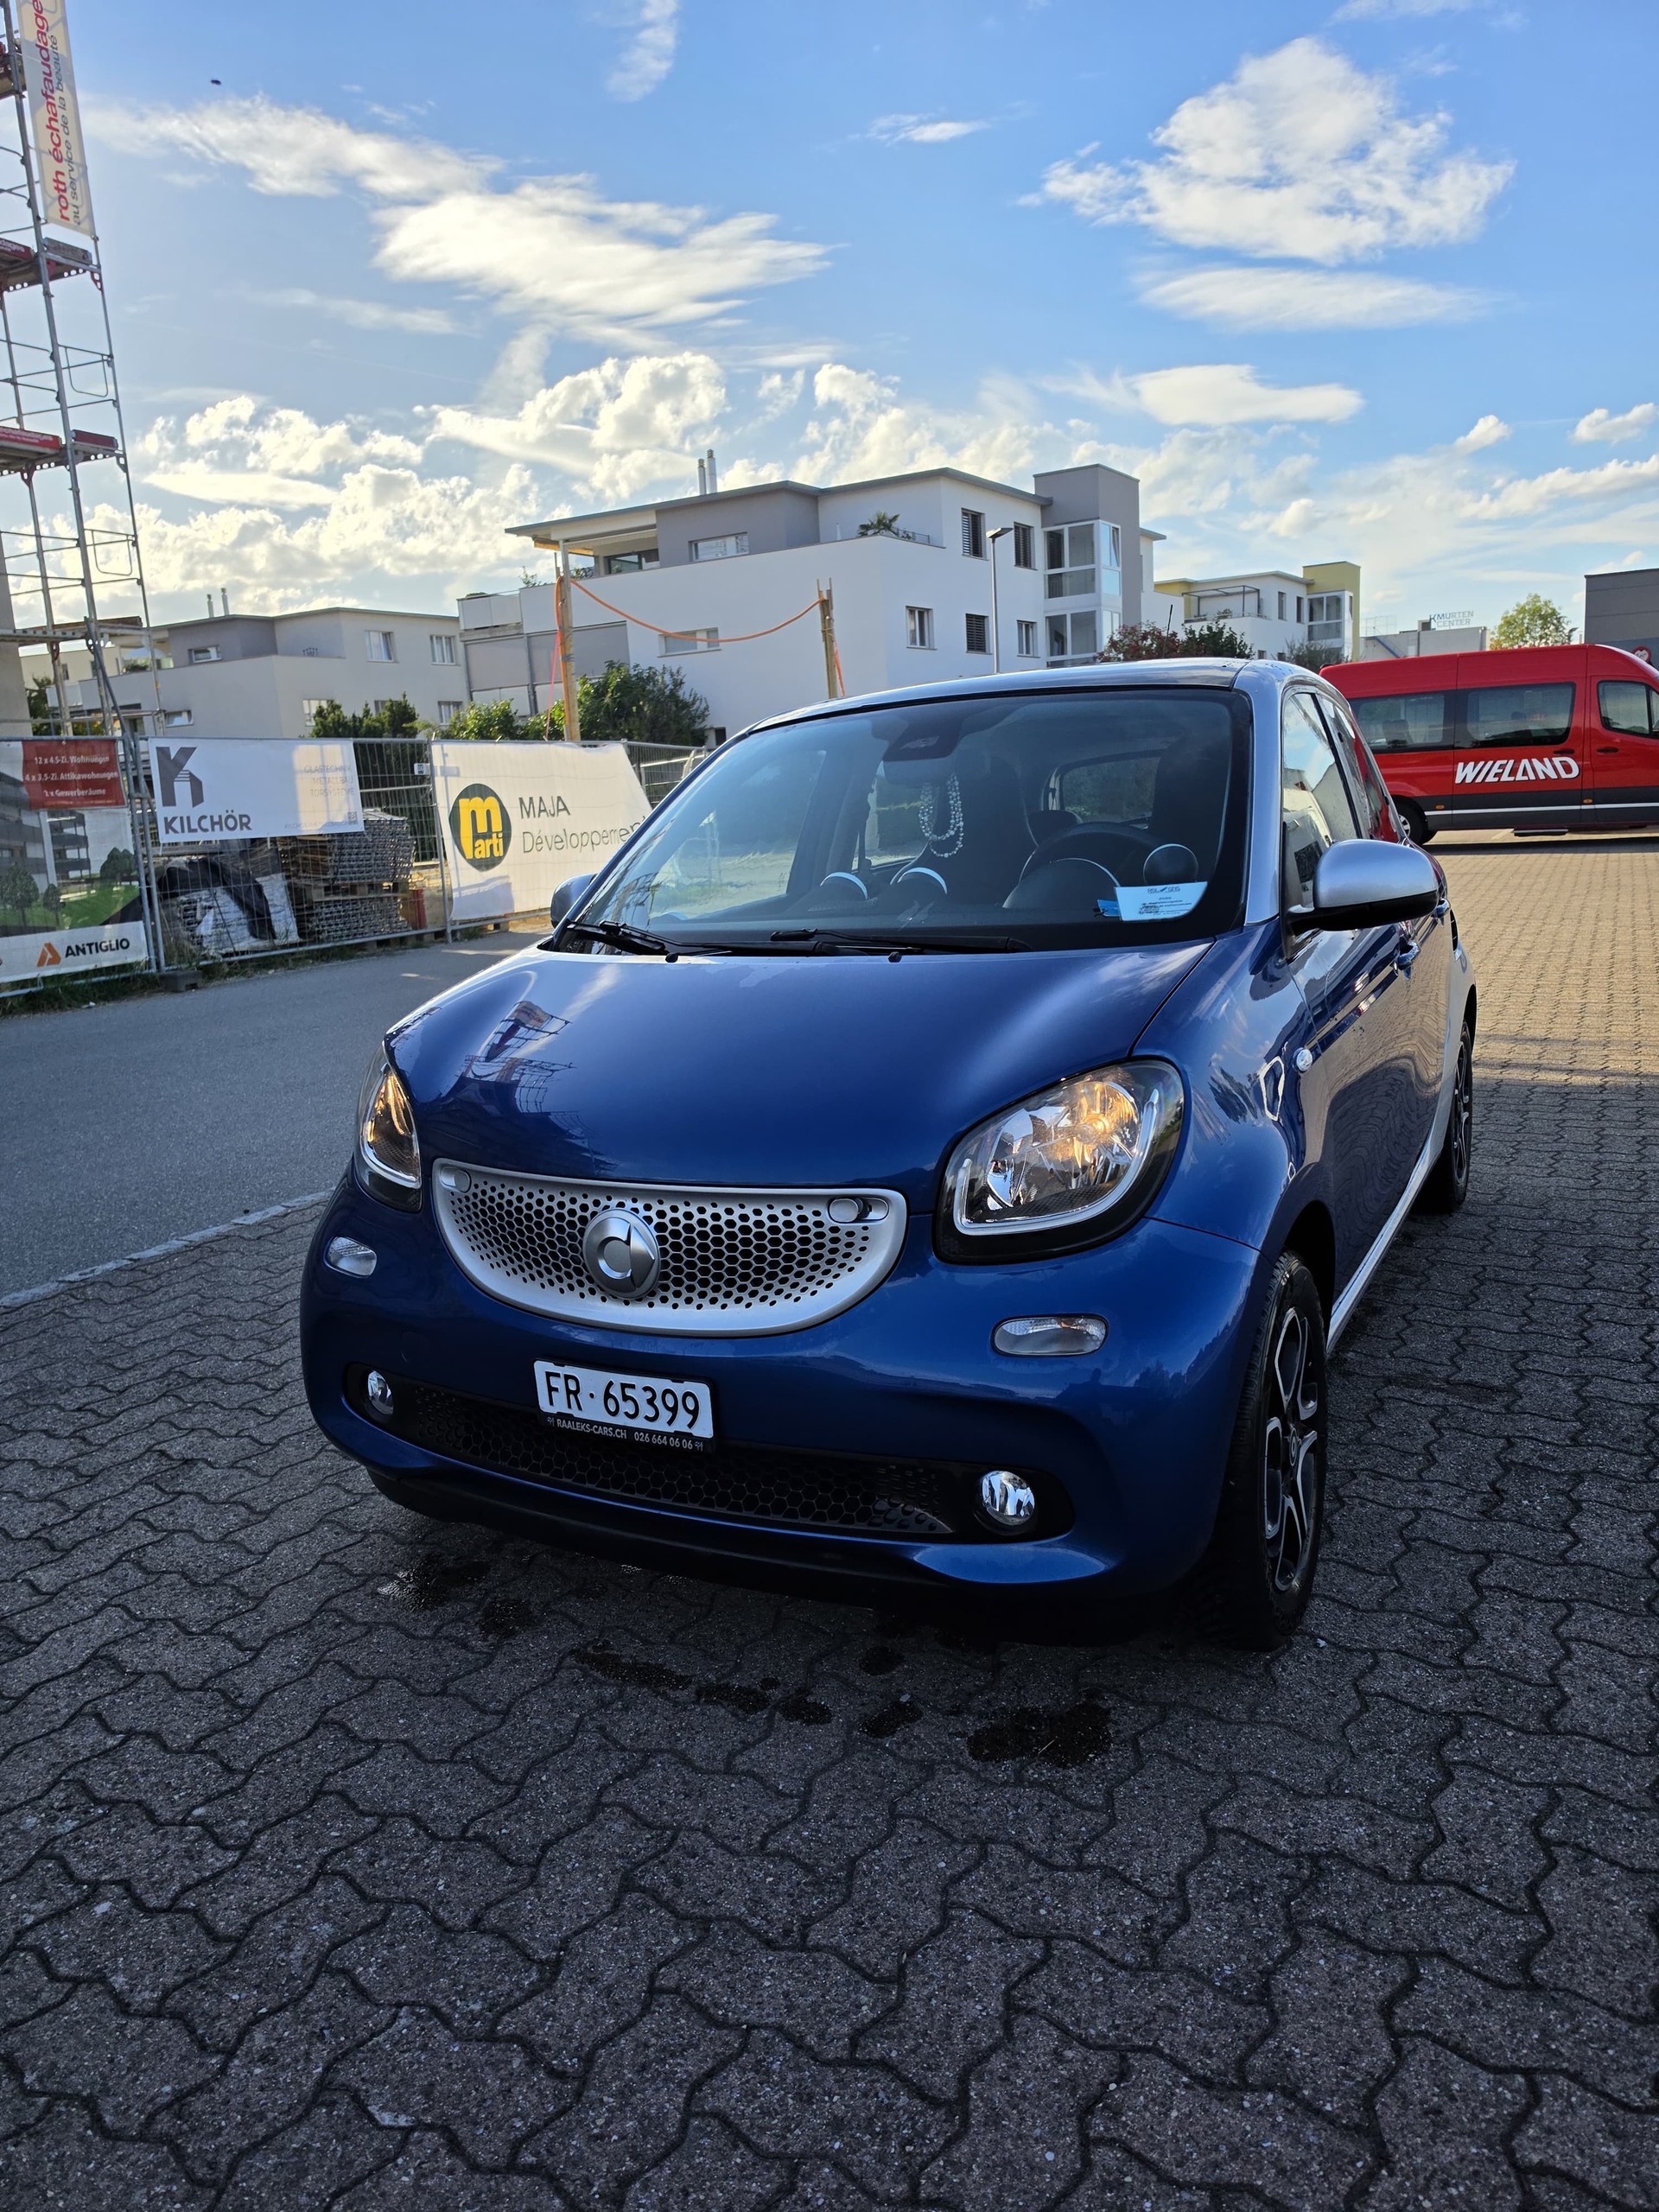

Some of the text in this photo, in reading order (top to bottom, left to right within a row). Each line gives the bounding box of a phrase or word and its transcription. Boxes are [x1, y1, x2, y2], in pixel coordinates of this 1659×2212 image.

[48, 35, 81, 226] au service de la beauté
[52, 170, 70, 221] roth
[1437, 610, 1474, 620] MURTEN
[1437, 619, 1471, 627] CENTER
[1455, 757, 1580, 784] WIELAND
[518, 796, 571, 819] MAJA
[163, 810, 253, 835] KILCHÖR
[522, 816, 645, 854] Développemen
[65, 938, 130, 958] ANTIGLIO
[545, 1371, 700, 1429] FR 65399
[556, 1418, 693, 1450] RAALEKS-CARS.CH 026 664 06 06
